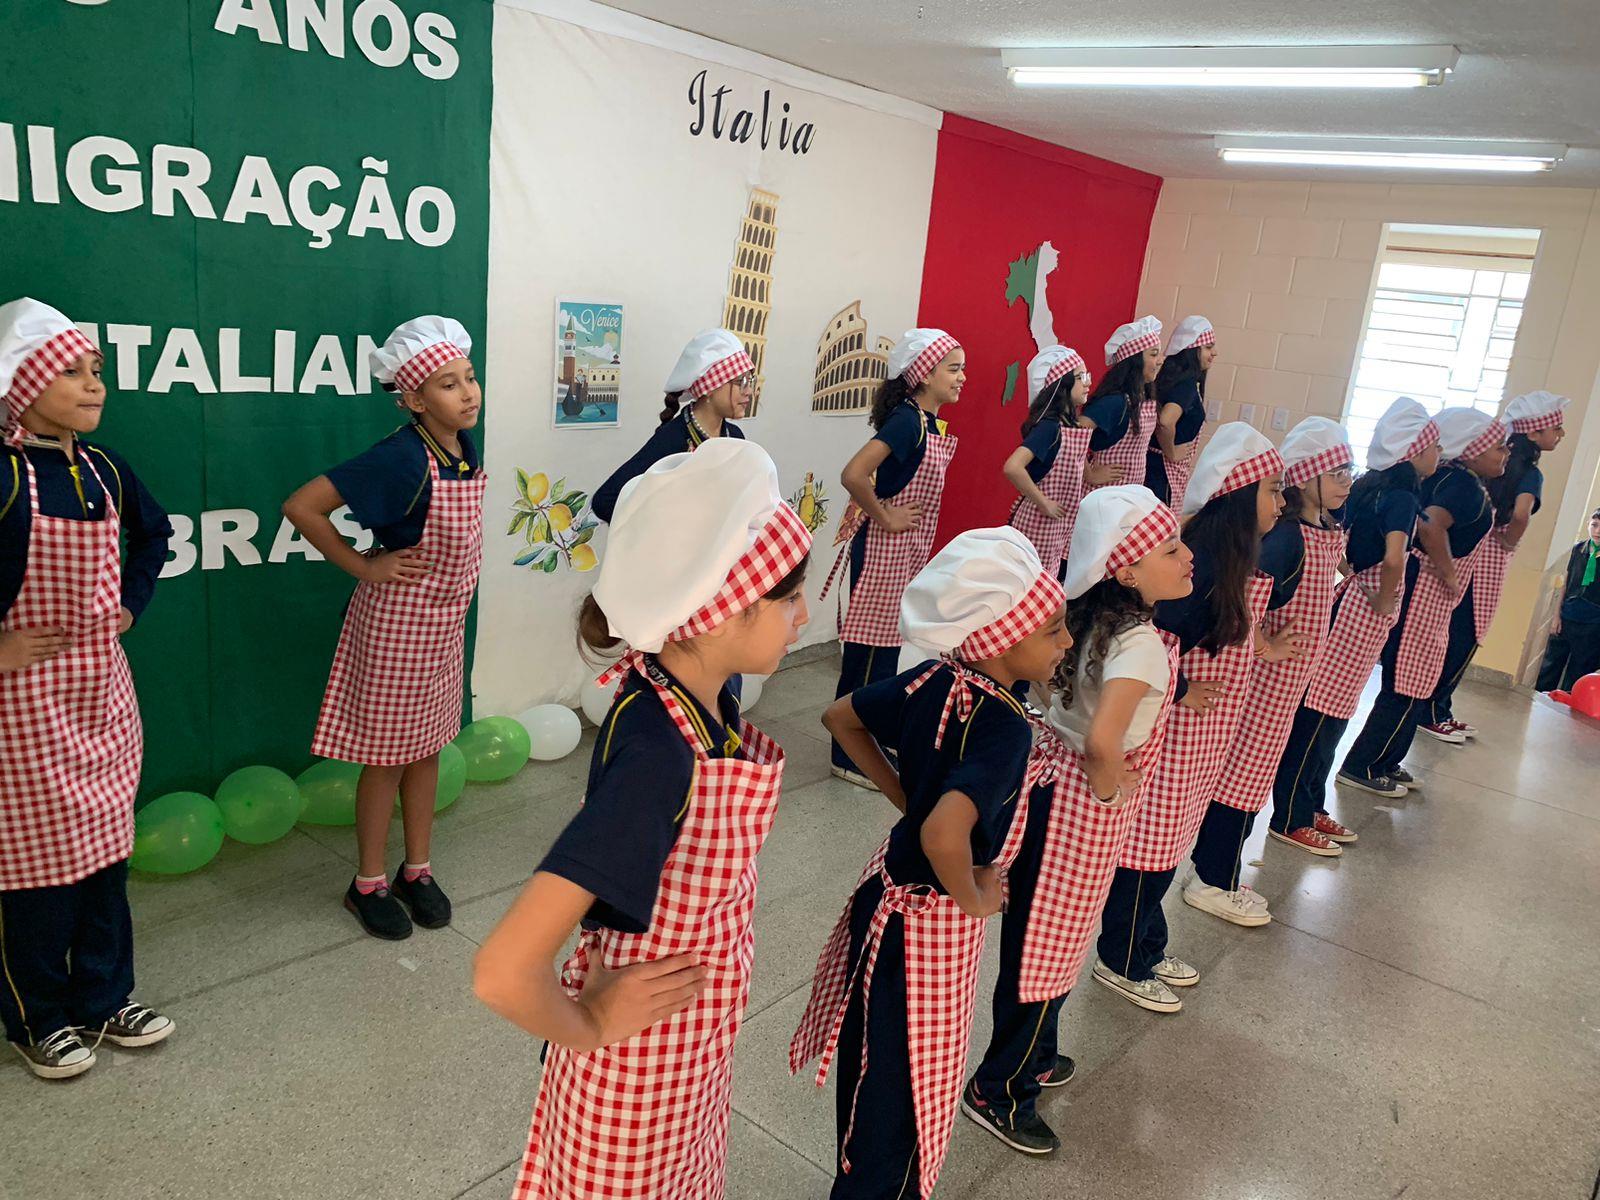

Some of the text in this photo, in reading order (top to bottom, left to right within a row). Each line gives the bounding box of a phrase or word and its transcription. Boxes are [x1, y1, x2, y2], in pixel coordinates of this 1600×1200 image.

[214, 0, 460, 80] ANOS
[688, 69, 817, 155] Italia
[580, 307, 620, 332] Venice
[74, 321, 403, 396] TALIA
[157, 503, 384, 579] BRAS
